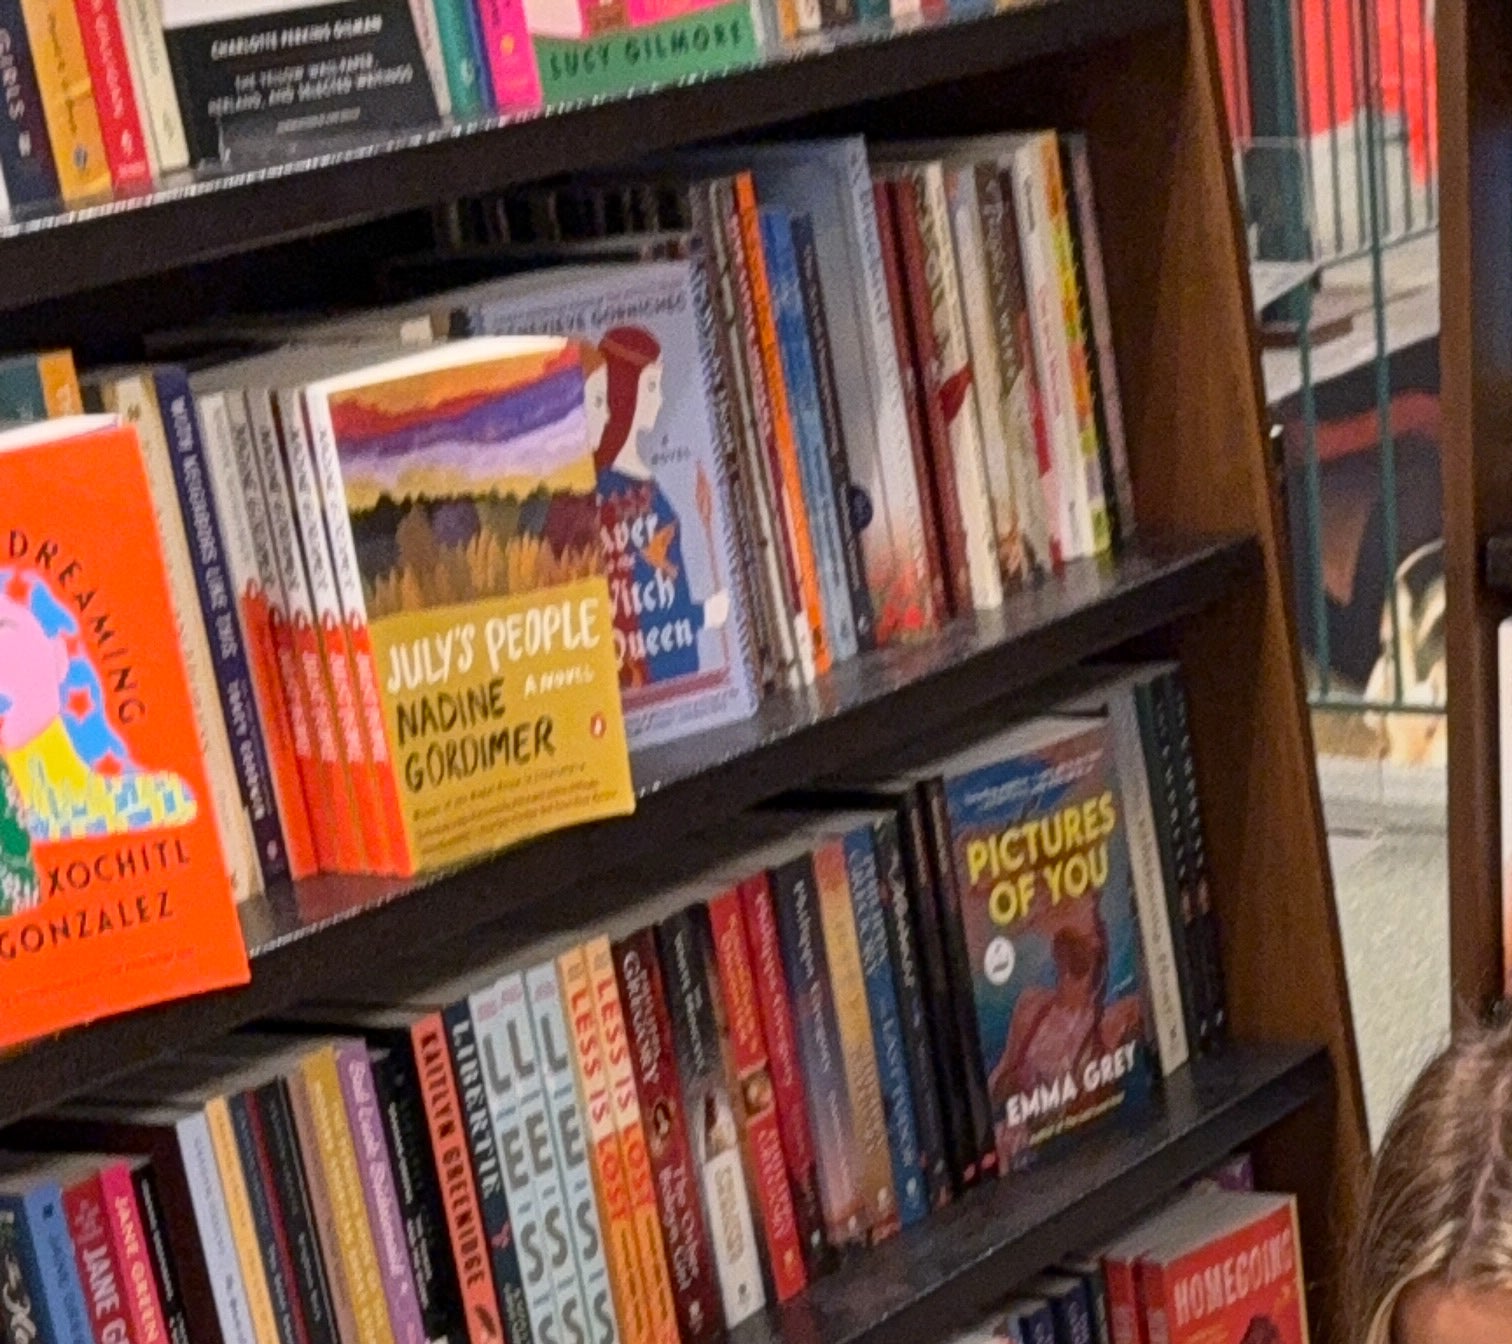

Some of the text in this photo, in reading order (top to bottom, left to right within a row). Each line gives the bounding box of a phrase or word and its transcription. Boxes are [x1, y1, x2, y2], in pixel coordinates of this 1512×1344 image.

[550, 21, 743, 80] LUCY GILMORE
[8, 528, 147, 725] DREAMING
[385, 598, 602, 695] JULY'S PEOPLE
[396, 679, 505, 746] NADINE
[404, 718, 557, 795] GORDIMER
[47, 838, 192, 899] XOCHITL
[967, 791, 1115, 886] PICTURES
[0, 890, 175, 961] GONZALEZ
[988, 848, 1108, 926] OF YOU
[448, 1020, 503, 1199] LIBERTIE
[572, 989, 631, 1223] LESS IS LOST
[597, 977, 655, 1211] LESS IS LOST
[1006, 1077, 1078, 1127] EMMA
[1084, 1045, 1137, 1096] GREY
[419, 1032, 485, 1287] KAITLYN GREENIDGE
[79, 1245, 122, 1317] JANE
[111, 1195, 163, 1343] JANE GREEN
[1174, 1230, 1293, 1326] HOMEGOING
